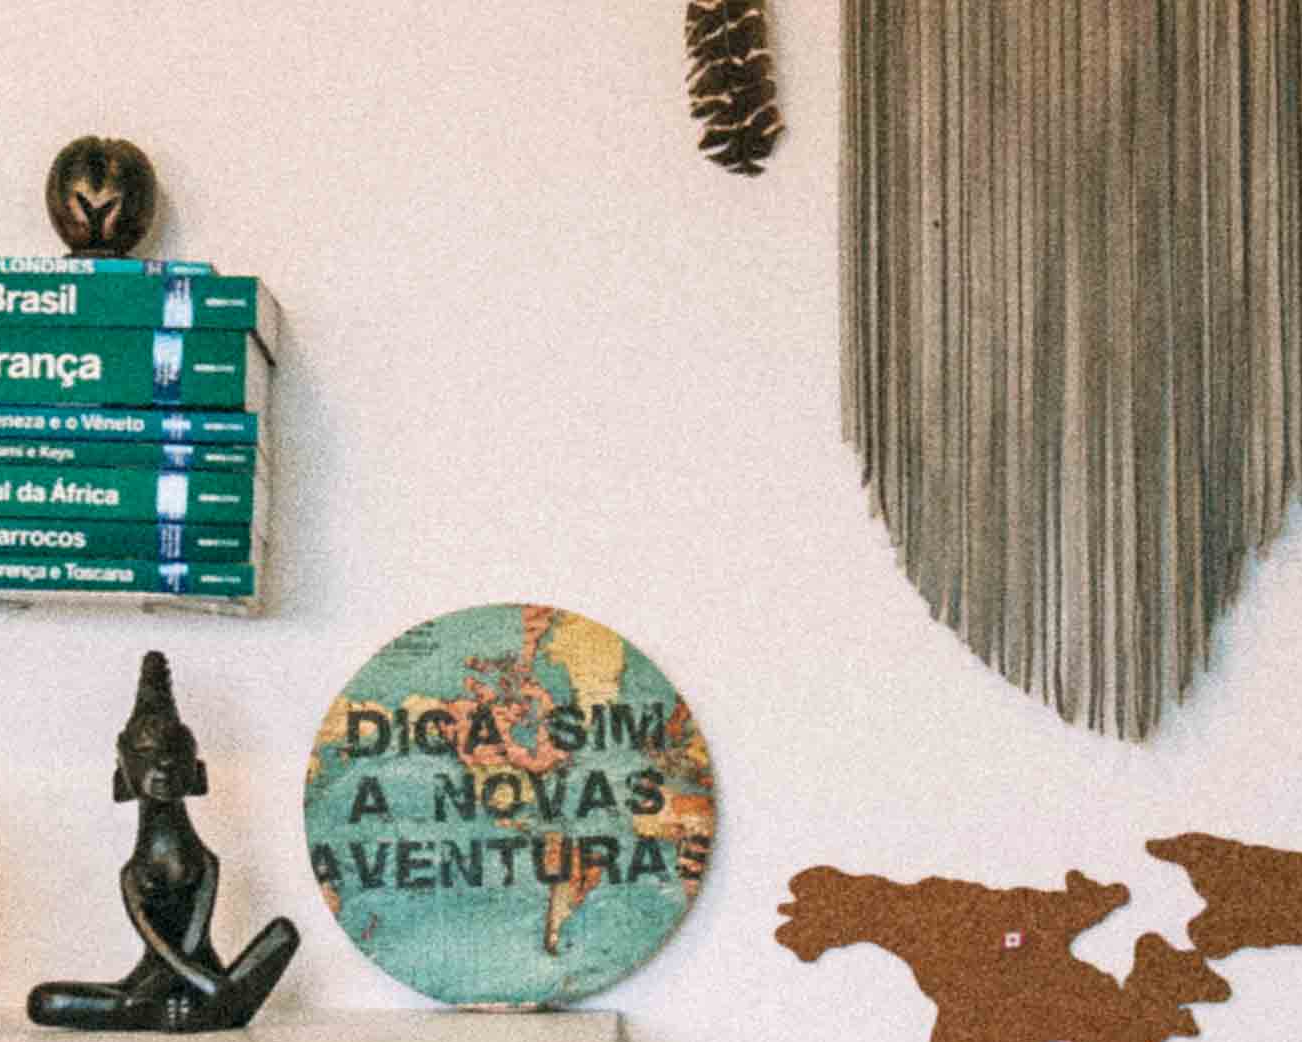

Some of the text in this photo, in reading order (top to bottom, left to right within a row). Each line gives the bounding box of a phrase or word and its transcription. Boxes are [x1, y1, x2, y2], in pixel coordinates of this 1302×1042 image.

[49, 416, 61, 430] e
[65, 416, 78, 430] o
[81, 412, 145, 432] Vêneto
[16, 481, 46, 504] da
[50, 477, 120, 506] África
[49, 565, 61, 580] e
[64, 562, 134, 583] Toscana
[345, 701, 666, 759] DIGA SIM
[348, 766, 665, 825] A NOVAS
[308, 834, 712, 889] AVENTURAS
